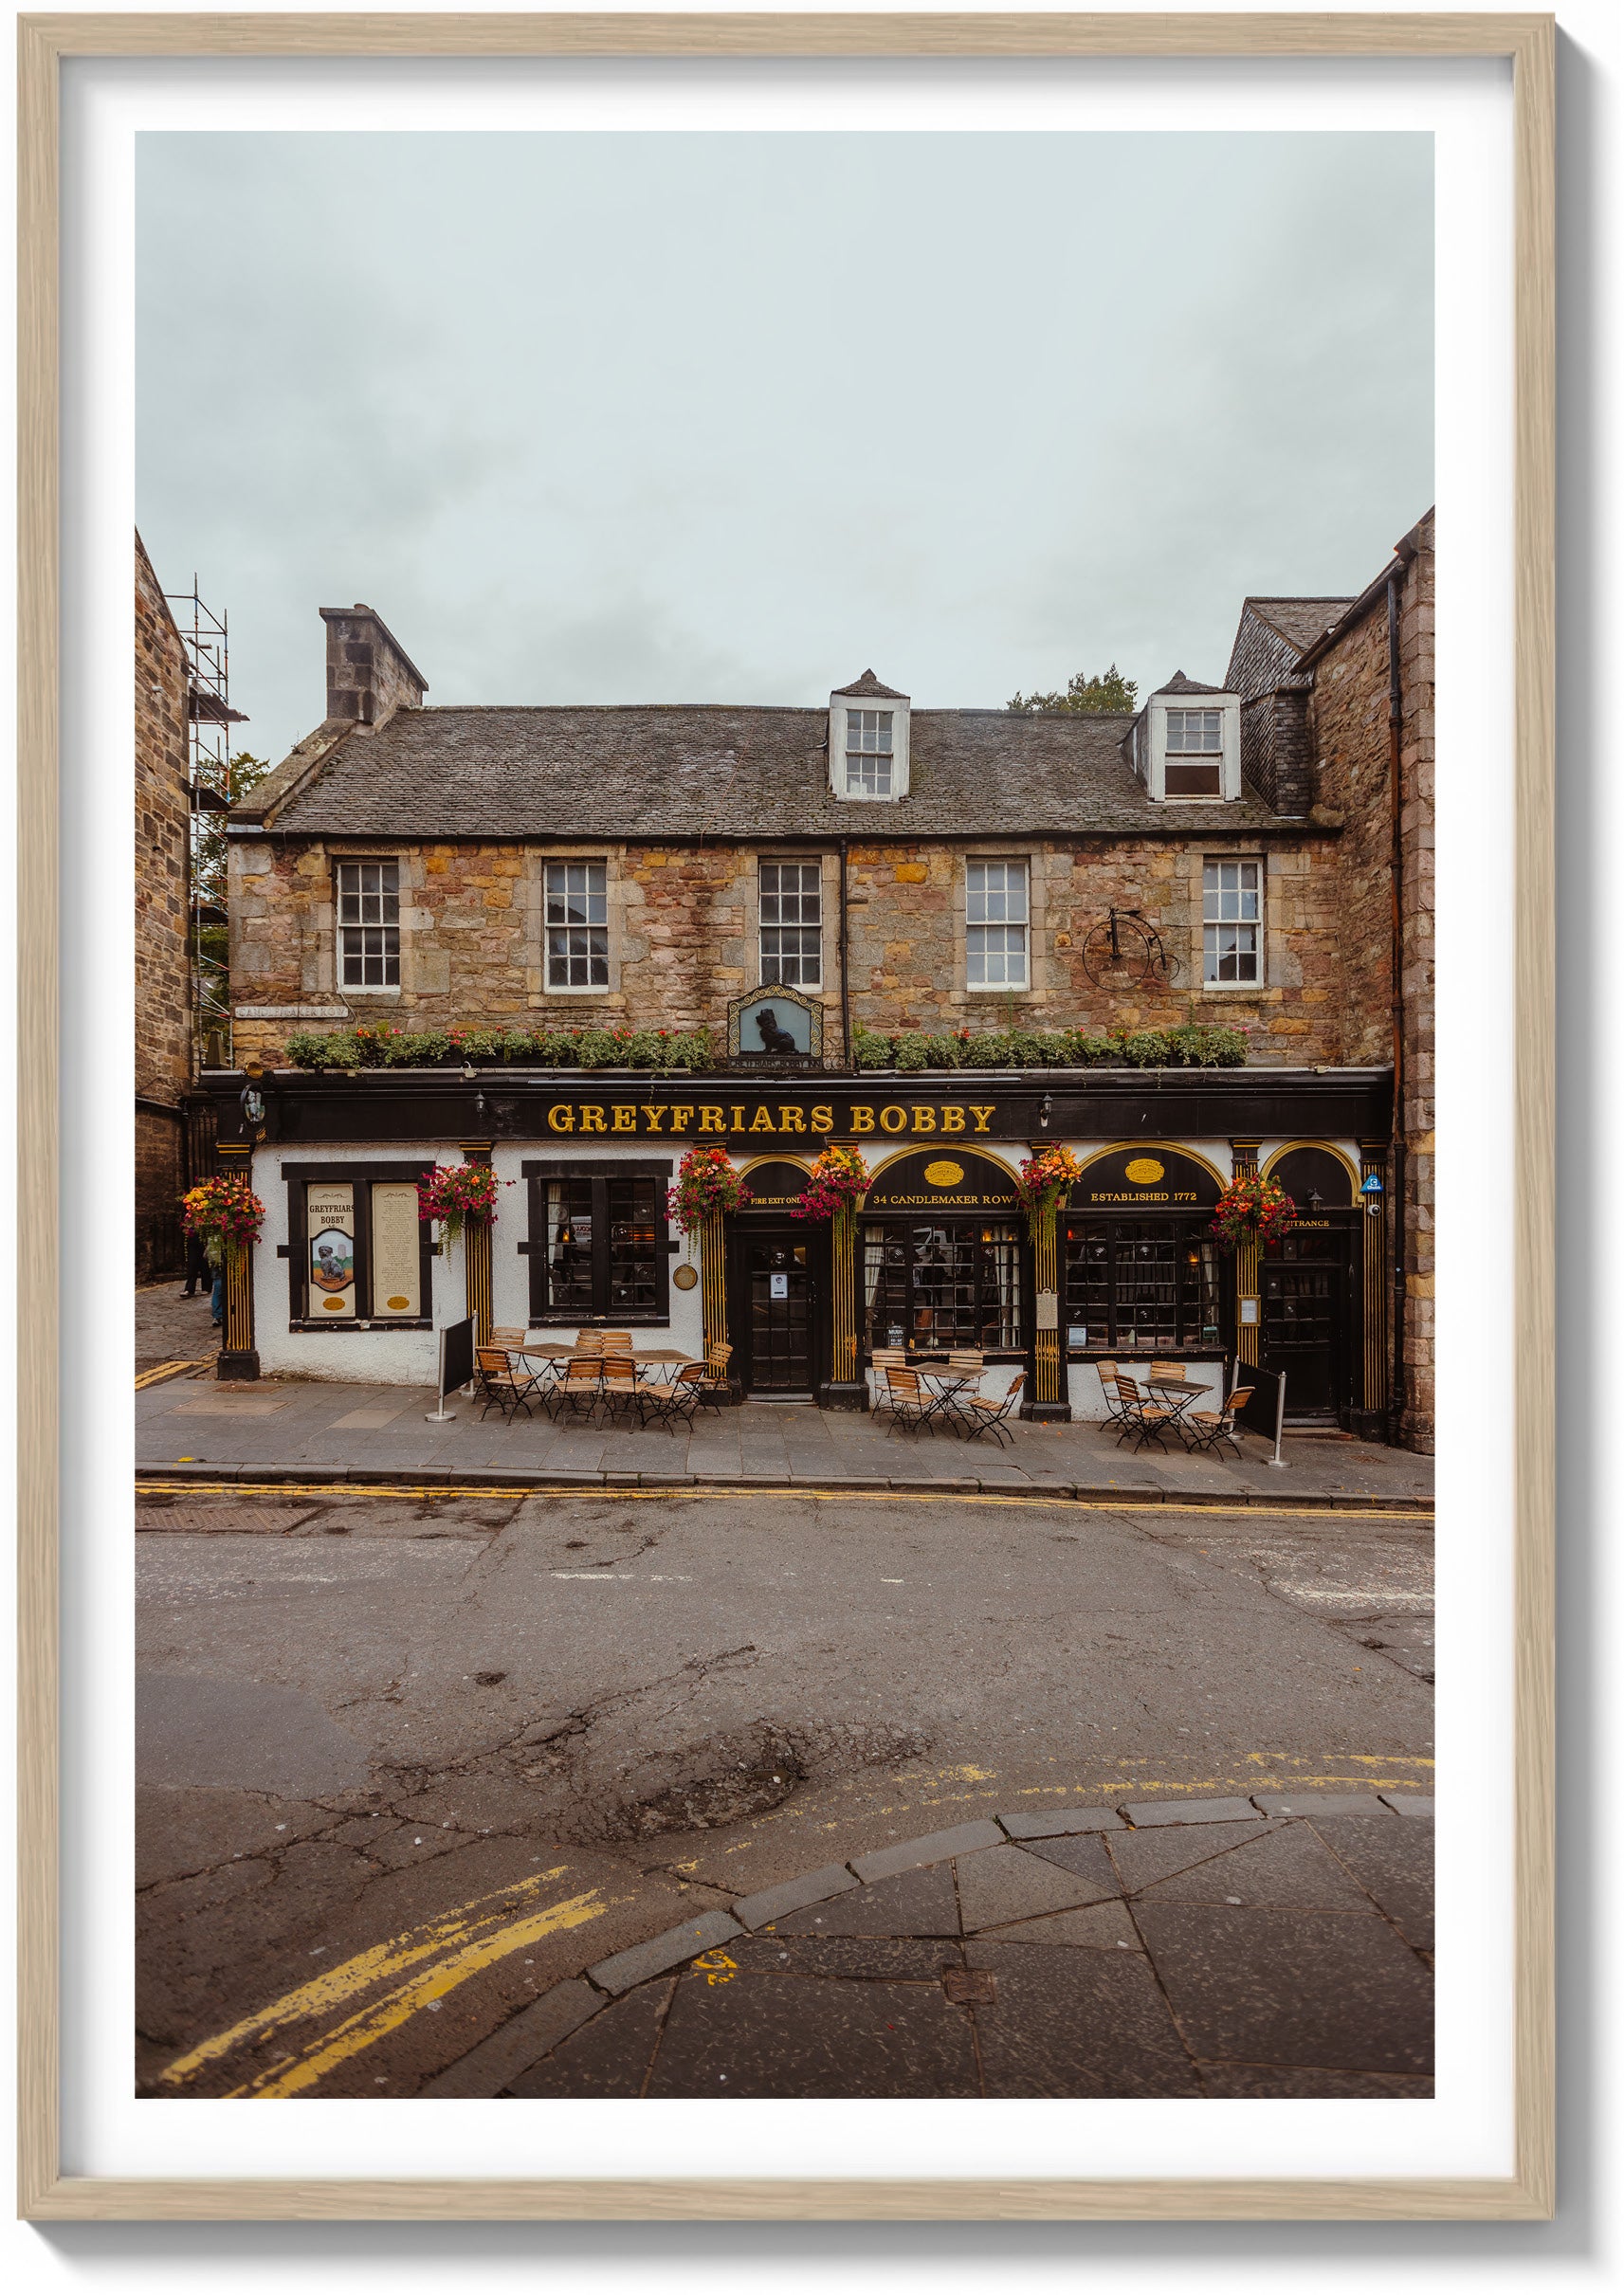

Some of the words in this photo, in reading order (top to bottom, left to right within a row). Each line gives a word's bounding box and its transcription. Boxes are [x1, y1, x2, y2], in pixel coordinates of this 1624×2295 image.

[238, 1007, 317, 1017] CANDLEMAKER
[319, 1006, 345, 1016] ROW
[780, 1059, 804, 1068] BOBBY
[547, 1103, 834, 1133] GREYFRIARS
[849, 1105, 995, 1133] BOBBY
[873, 1195, 887, 1204] 34
[890, 1195, 978, 1204] CANDLEMAKER
[982, 1195, 1014, 1204] ROW
[1091, 1192, 1169, 1201] ESTABLISHED
[1173, 1192, 1197, 1201] 1772
[309, 1204, 355, 1213] GREYFRIARS
[320, 1215, 345, 1225] BOBBY
